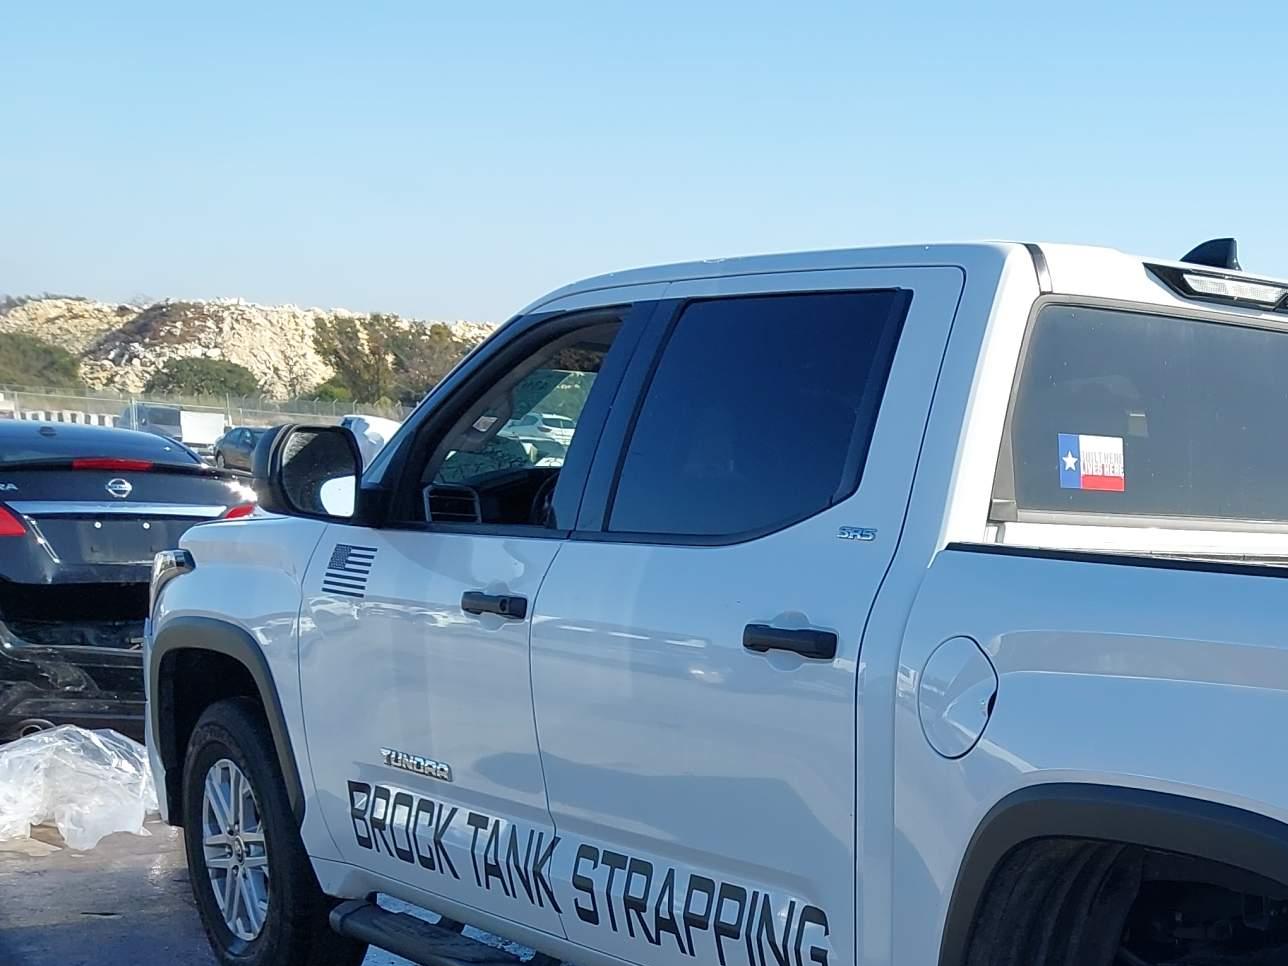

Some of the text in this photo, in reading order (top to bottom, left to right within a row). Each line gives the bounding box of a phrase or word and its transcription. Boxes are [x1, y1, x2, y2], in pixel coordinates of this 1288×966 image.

[837, 526, 878, 541] SR5
[380, 747, 453, 782] TUNDRA
[346, 779, 460, 880] BROCK
[466, 811, 563, 914] TANK
